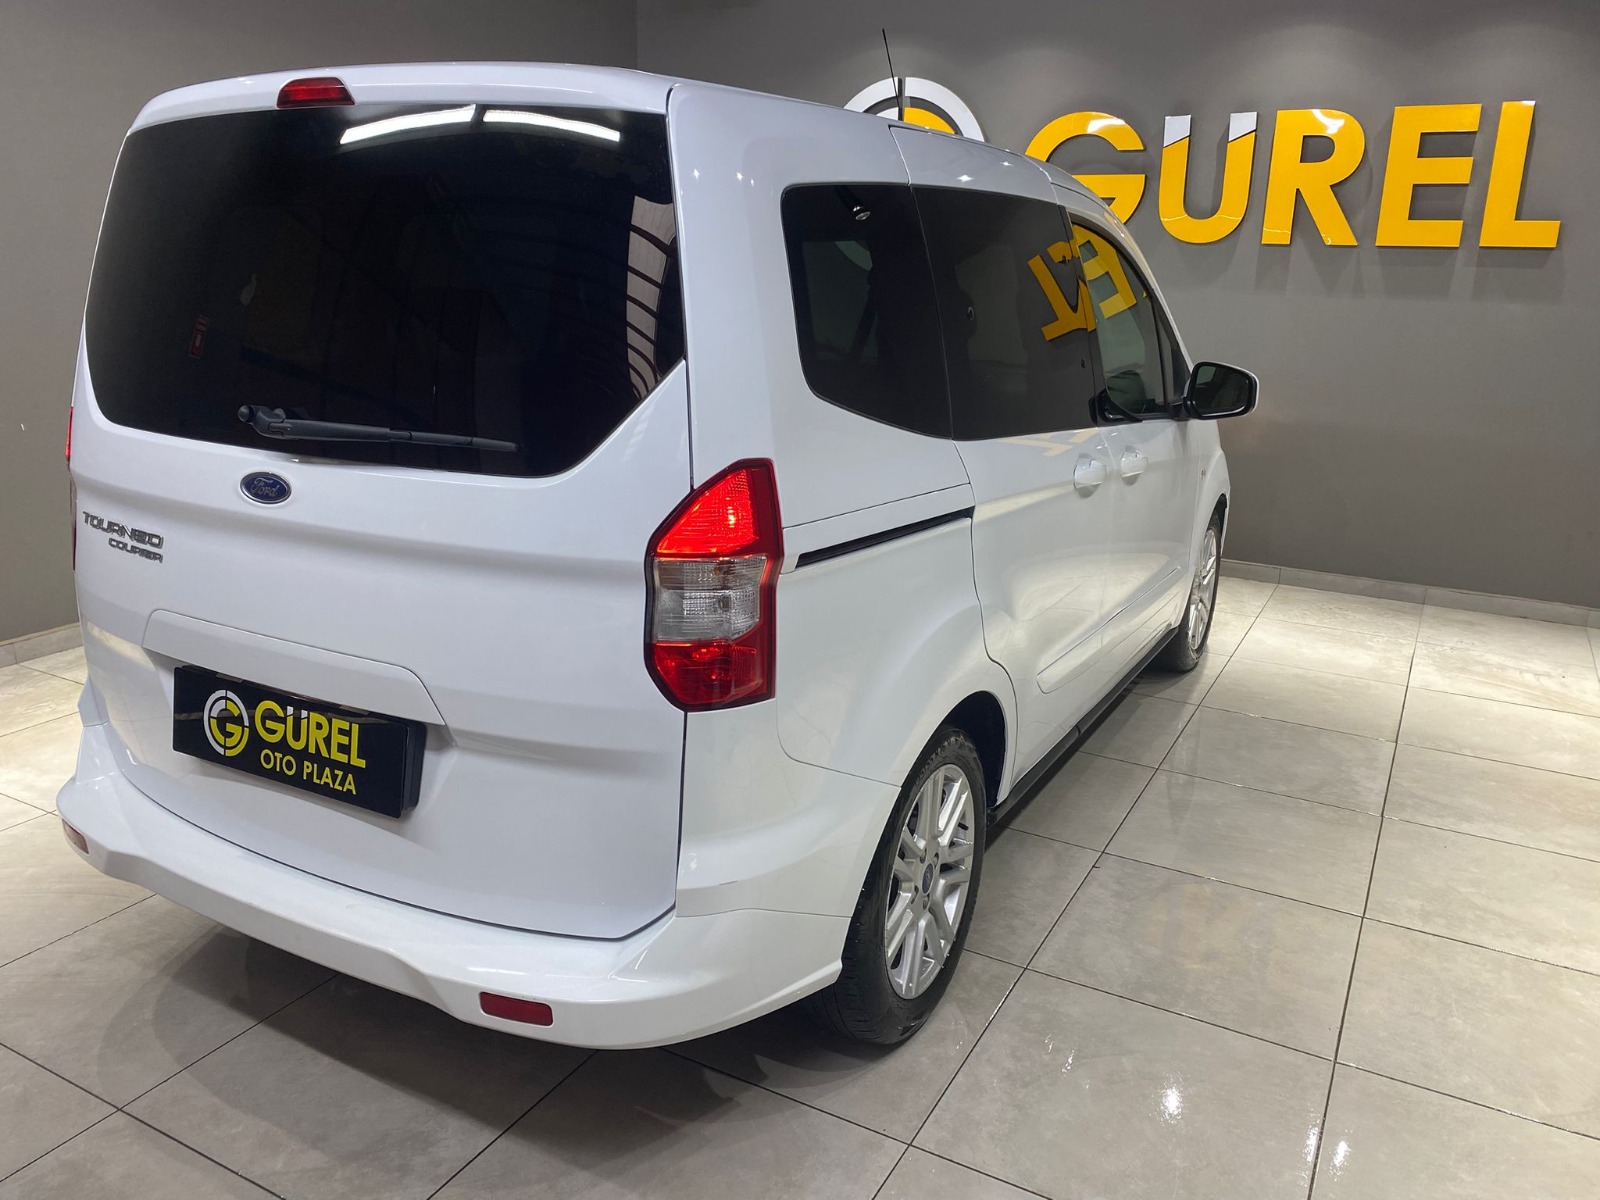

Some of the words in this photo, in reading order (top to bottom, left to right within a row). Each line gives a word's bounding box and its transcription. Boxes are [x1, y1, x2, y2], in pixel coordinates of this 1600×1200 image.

[82, 510, 165, 549] TOURNEO
[260, 748, 297, 776] OTO
[303, 760, 358, 796] PLAZA
